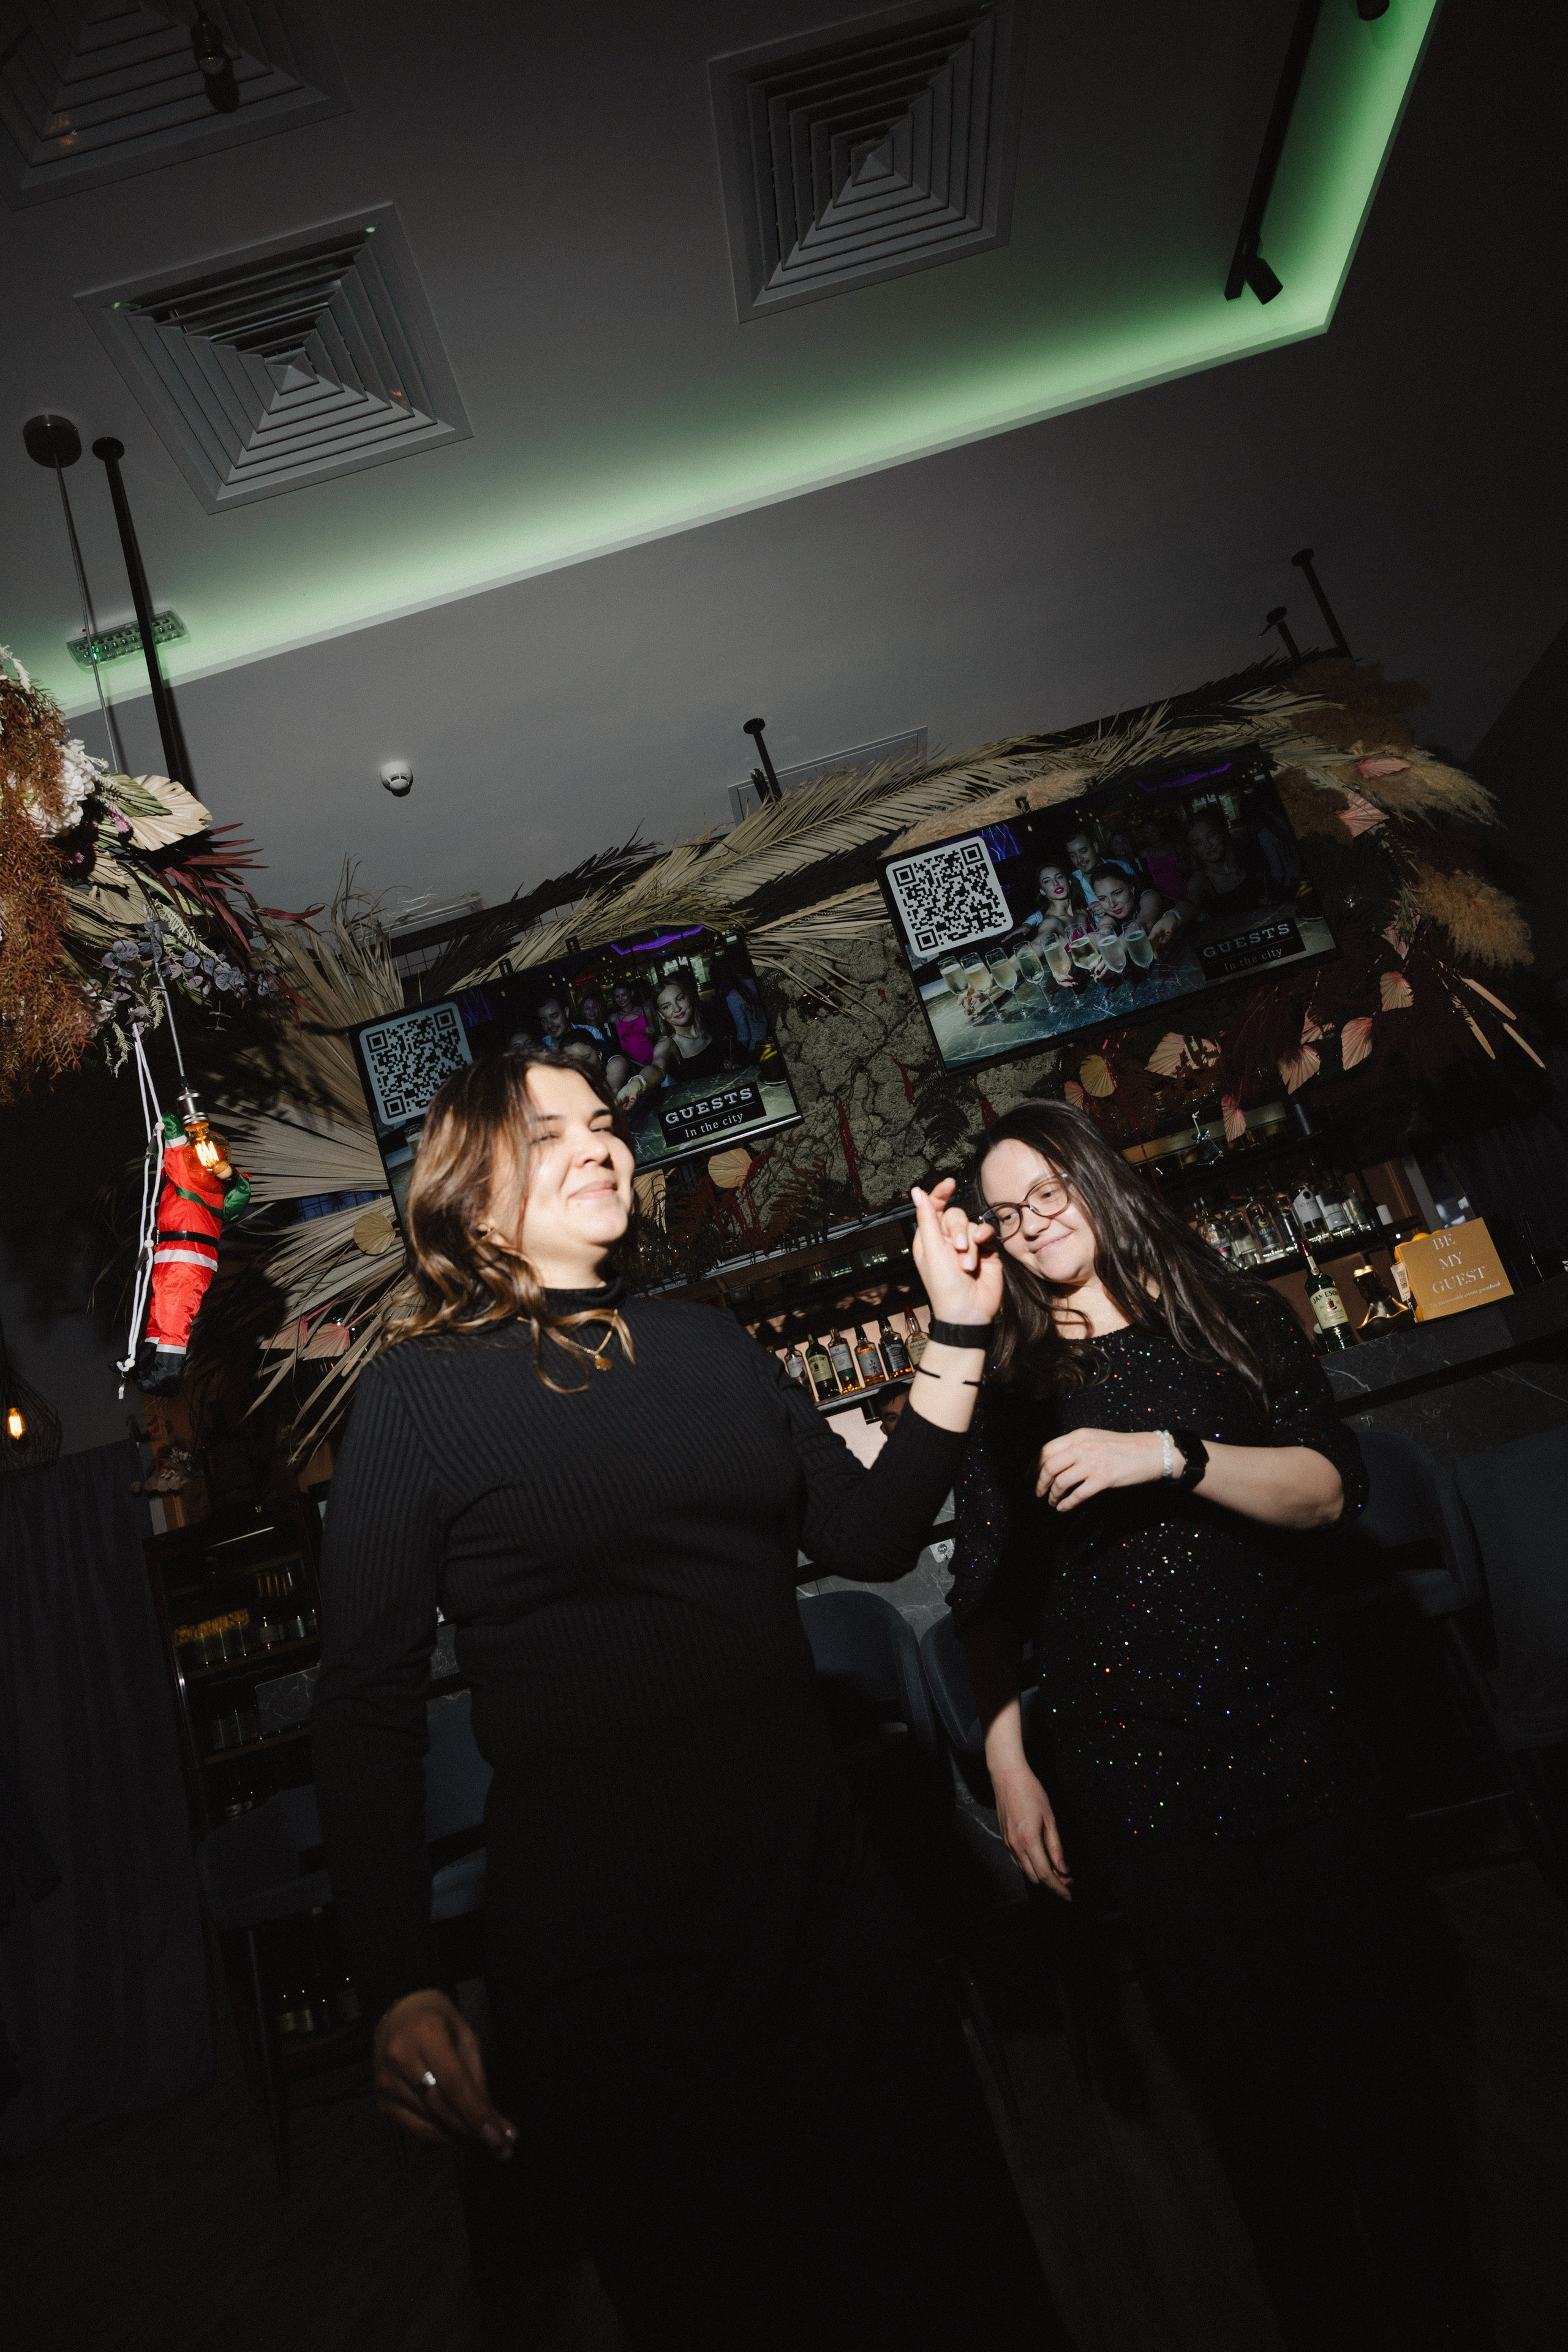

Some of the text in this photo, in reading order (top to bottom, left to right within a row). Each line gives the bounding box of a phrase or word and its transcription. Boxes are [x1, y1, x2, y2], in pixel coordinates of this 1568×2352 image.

[1203, 923, 1290, 957] GUESTS
[1224, 948, 1282, 971] In the city
[665, 1088, 752, 1124] GUESTS
[685, 1113, 743, 1138] In the city
[1432, 1234, 1455, 1250] BE
[1439, 1251, 1461, 1270] MY
[1432, 1266, 1485, 1293] GUEST
[1479, 1281, 1501, 1294] guestbook
